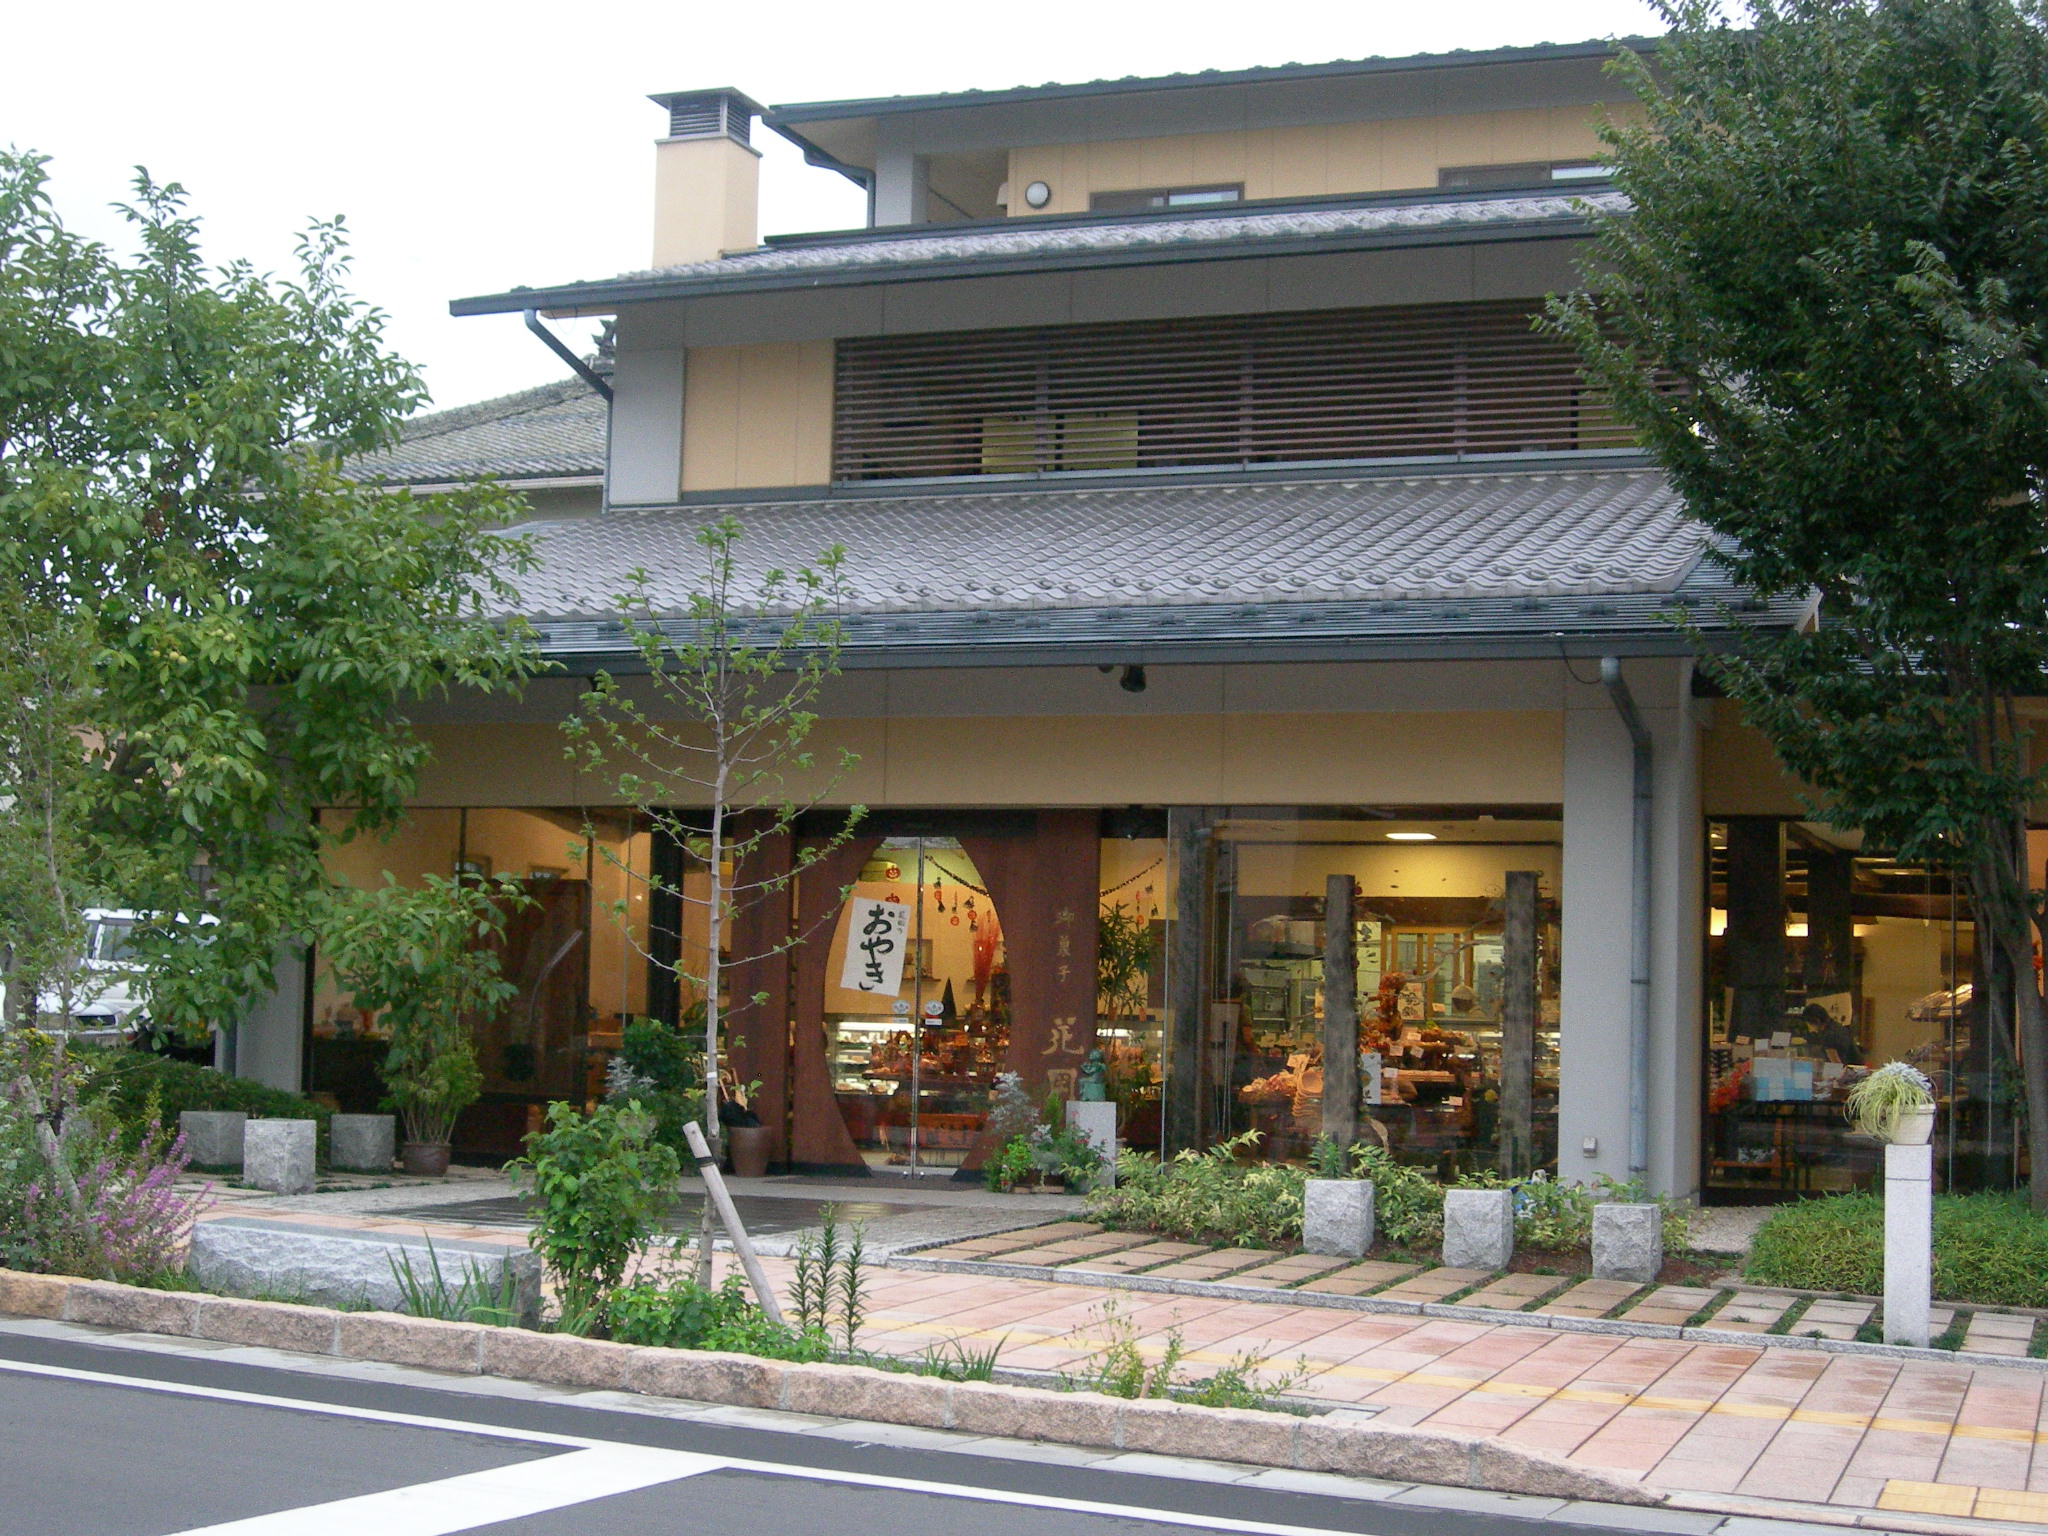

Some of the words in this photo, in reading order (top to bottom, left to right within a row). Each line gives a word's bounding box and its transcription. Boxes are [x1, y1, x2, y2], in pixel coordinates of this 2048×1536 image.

[858, 903, 895, 991] おやき
[1055, 907, 1075, 983] 御菓子
